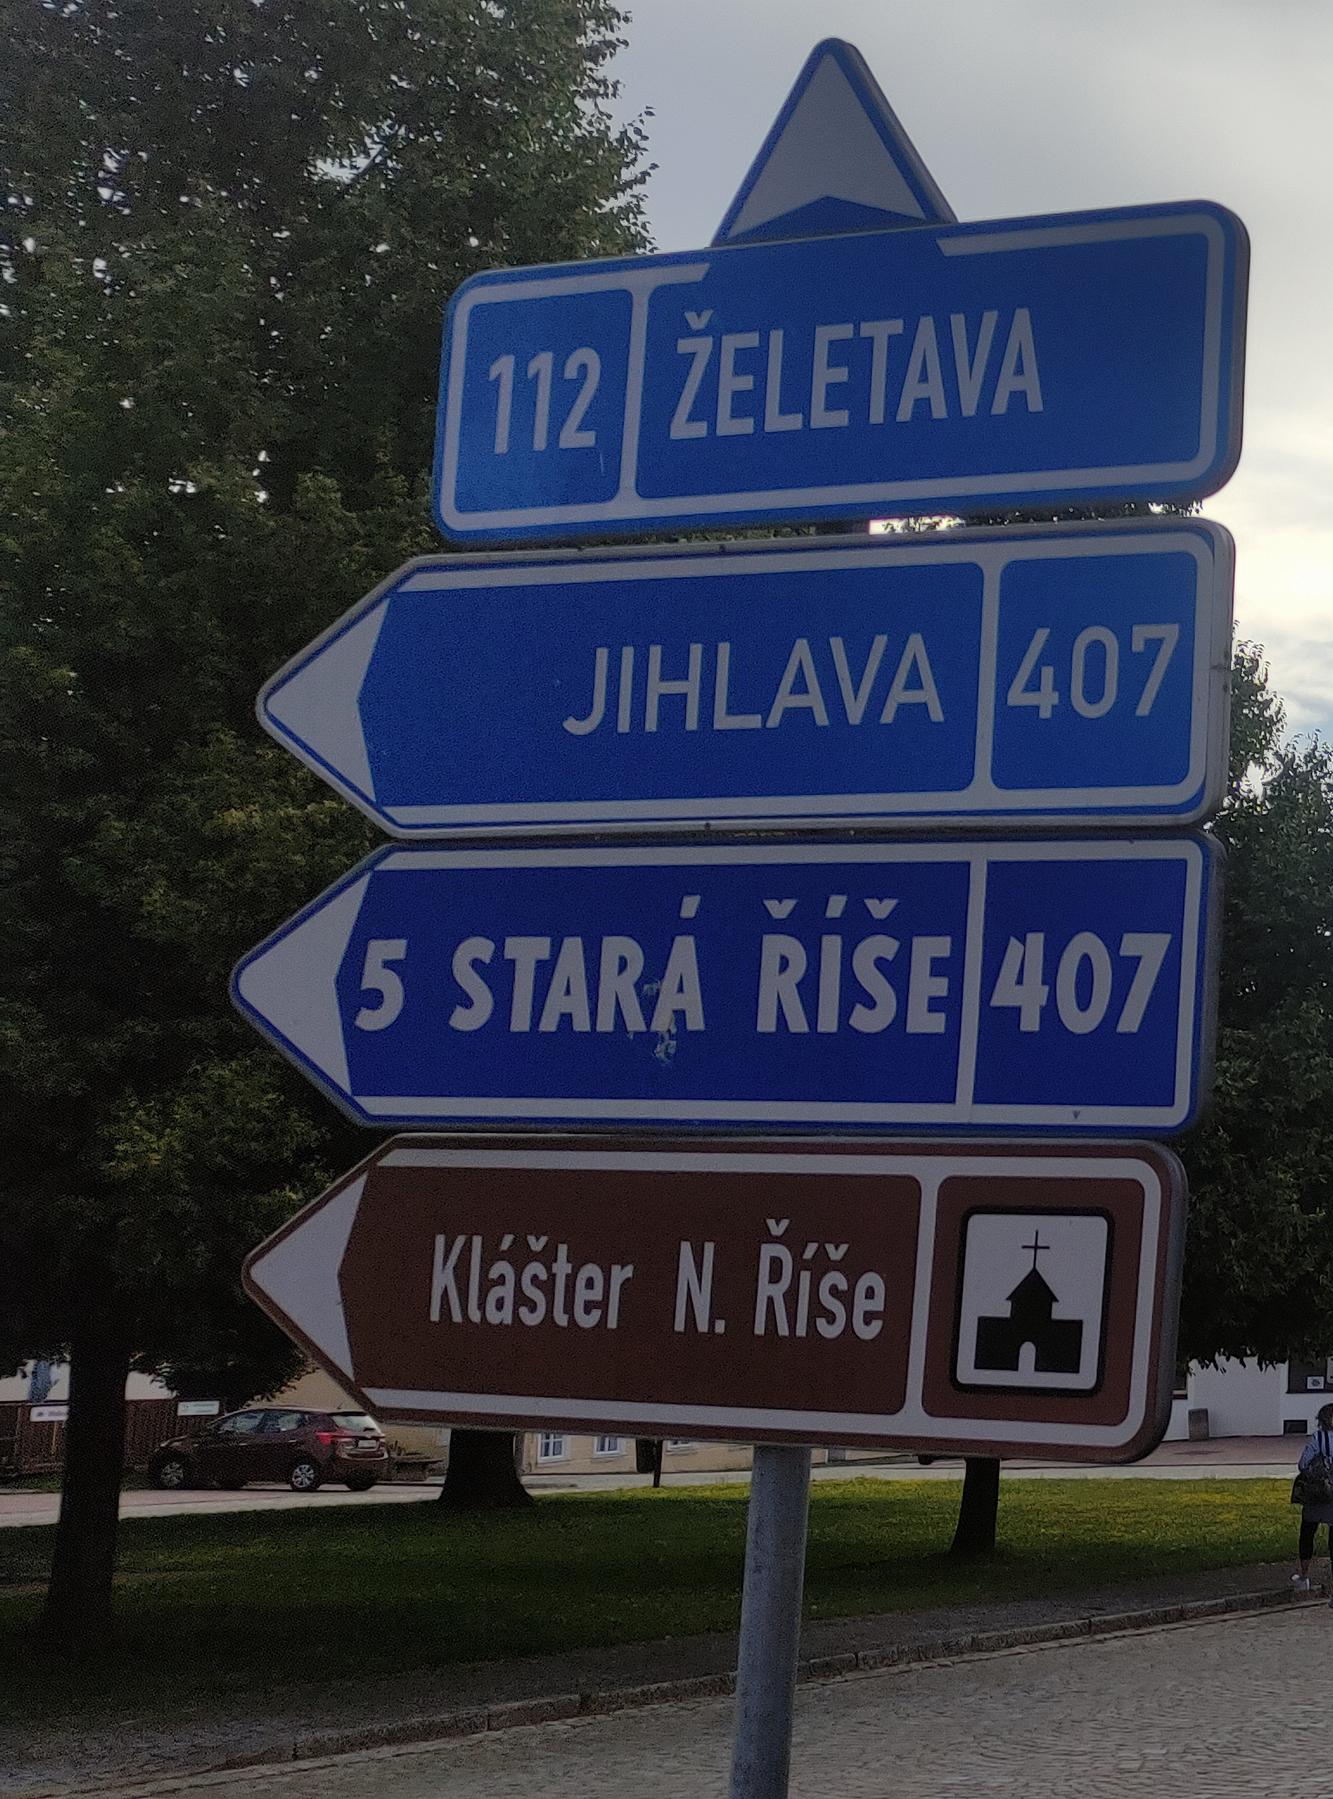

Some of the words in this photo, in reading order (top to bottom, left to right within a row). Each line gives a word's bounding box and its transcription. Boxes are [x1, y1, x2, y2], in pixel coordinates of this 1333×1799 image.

[489, 346, 600, 455] 112
[669, 307, 1044, 440] ŽELETAVA
[562, 633, 945, 736] JIHLAVA
[1007, 624, 1180, 720] 407
[353, 938, 407, 1031] 5
[449, 894, 707, 1034] STARÁ
[756, 894, 953, 1035] ŘÍŠE
[990, 931, 1173, 1034] 407
[429, 1233, 634, 1330] Klášter
[674, 1240, 726, 1335] N.
[754, 1218, 886, 1341] Říše
